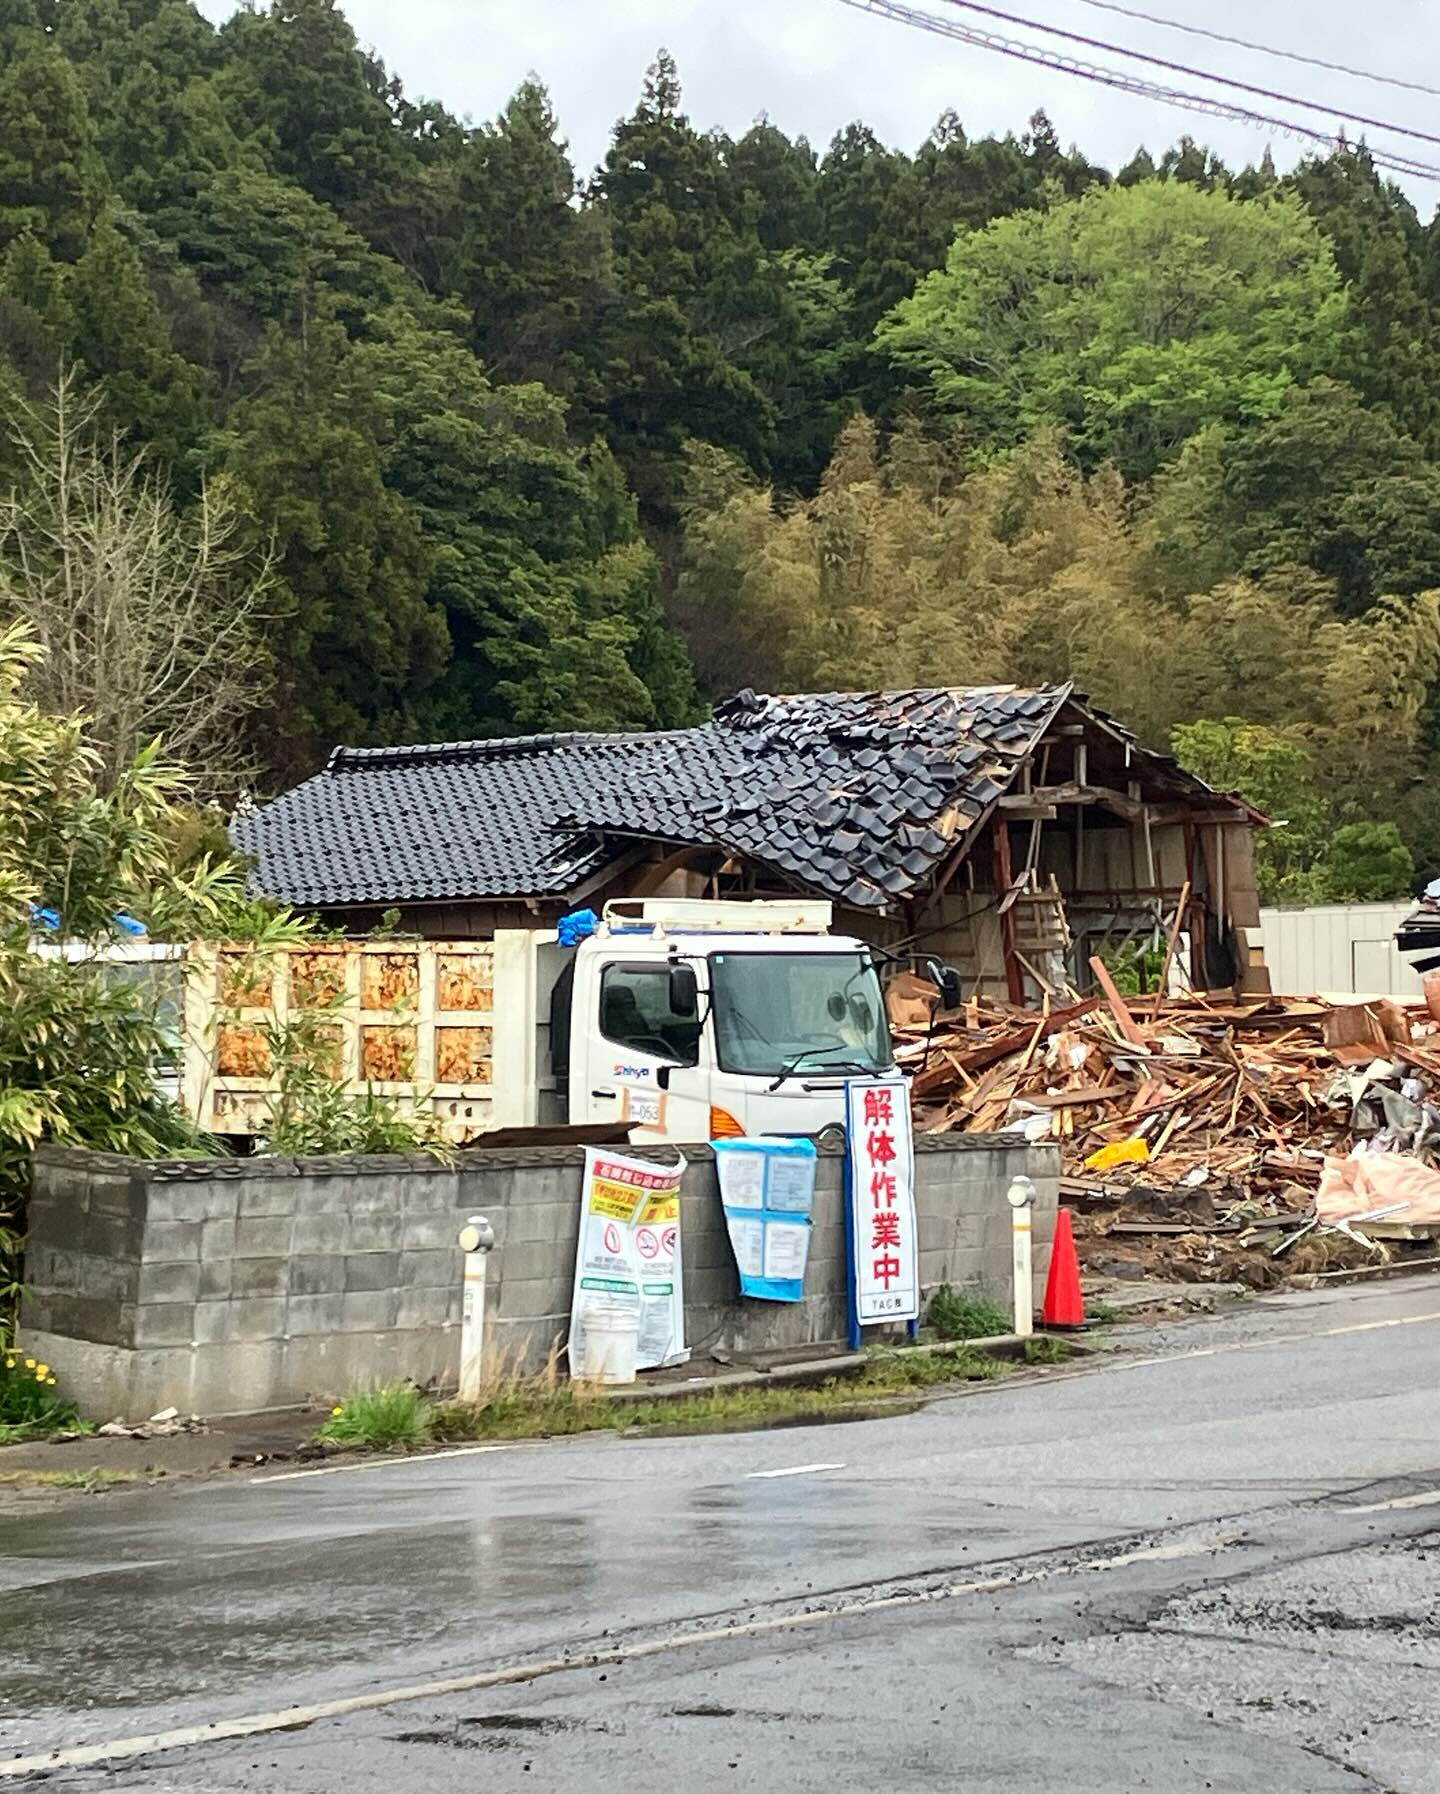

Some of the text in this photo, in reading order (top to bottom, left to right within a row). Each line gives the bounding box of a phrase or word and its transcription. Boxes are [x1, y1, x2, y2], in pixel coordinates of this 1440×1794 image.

[863, 1089, 901, 1291] 解体作業中
